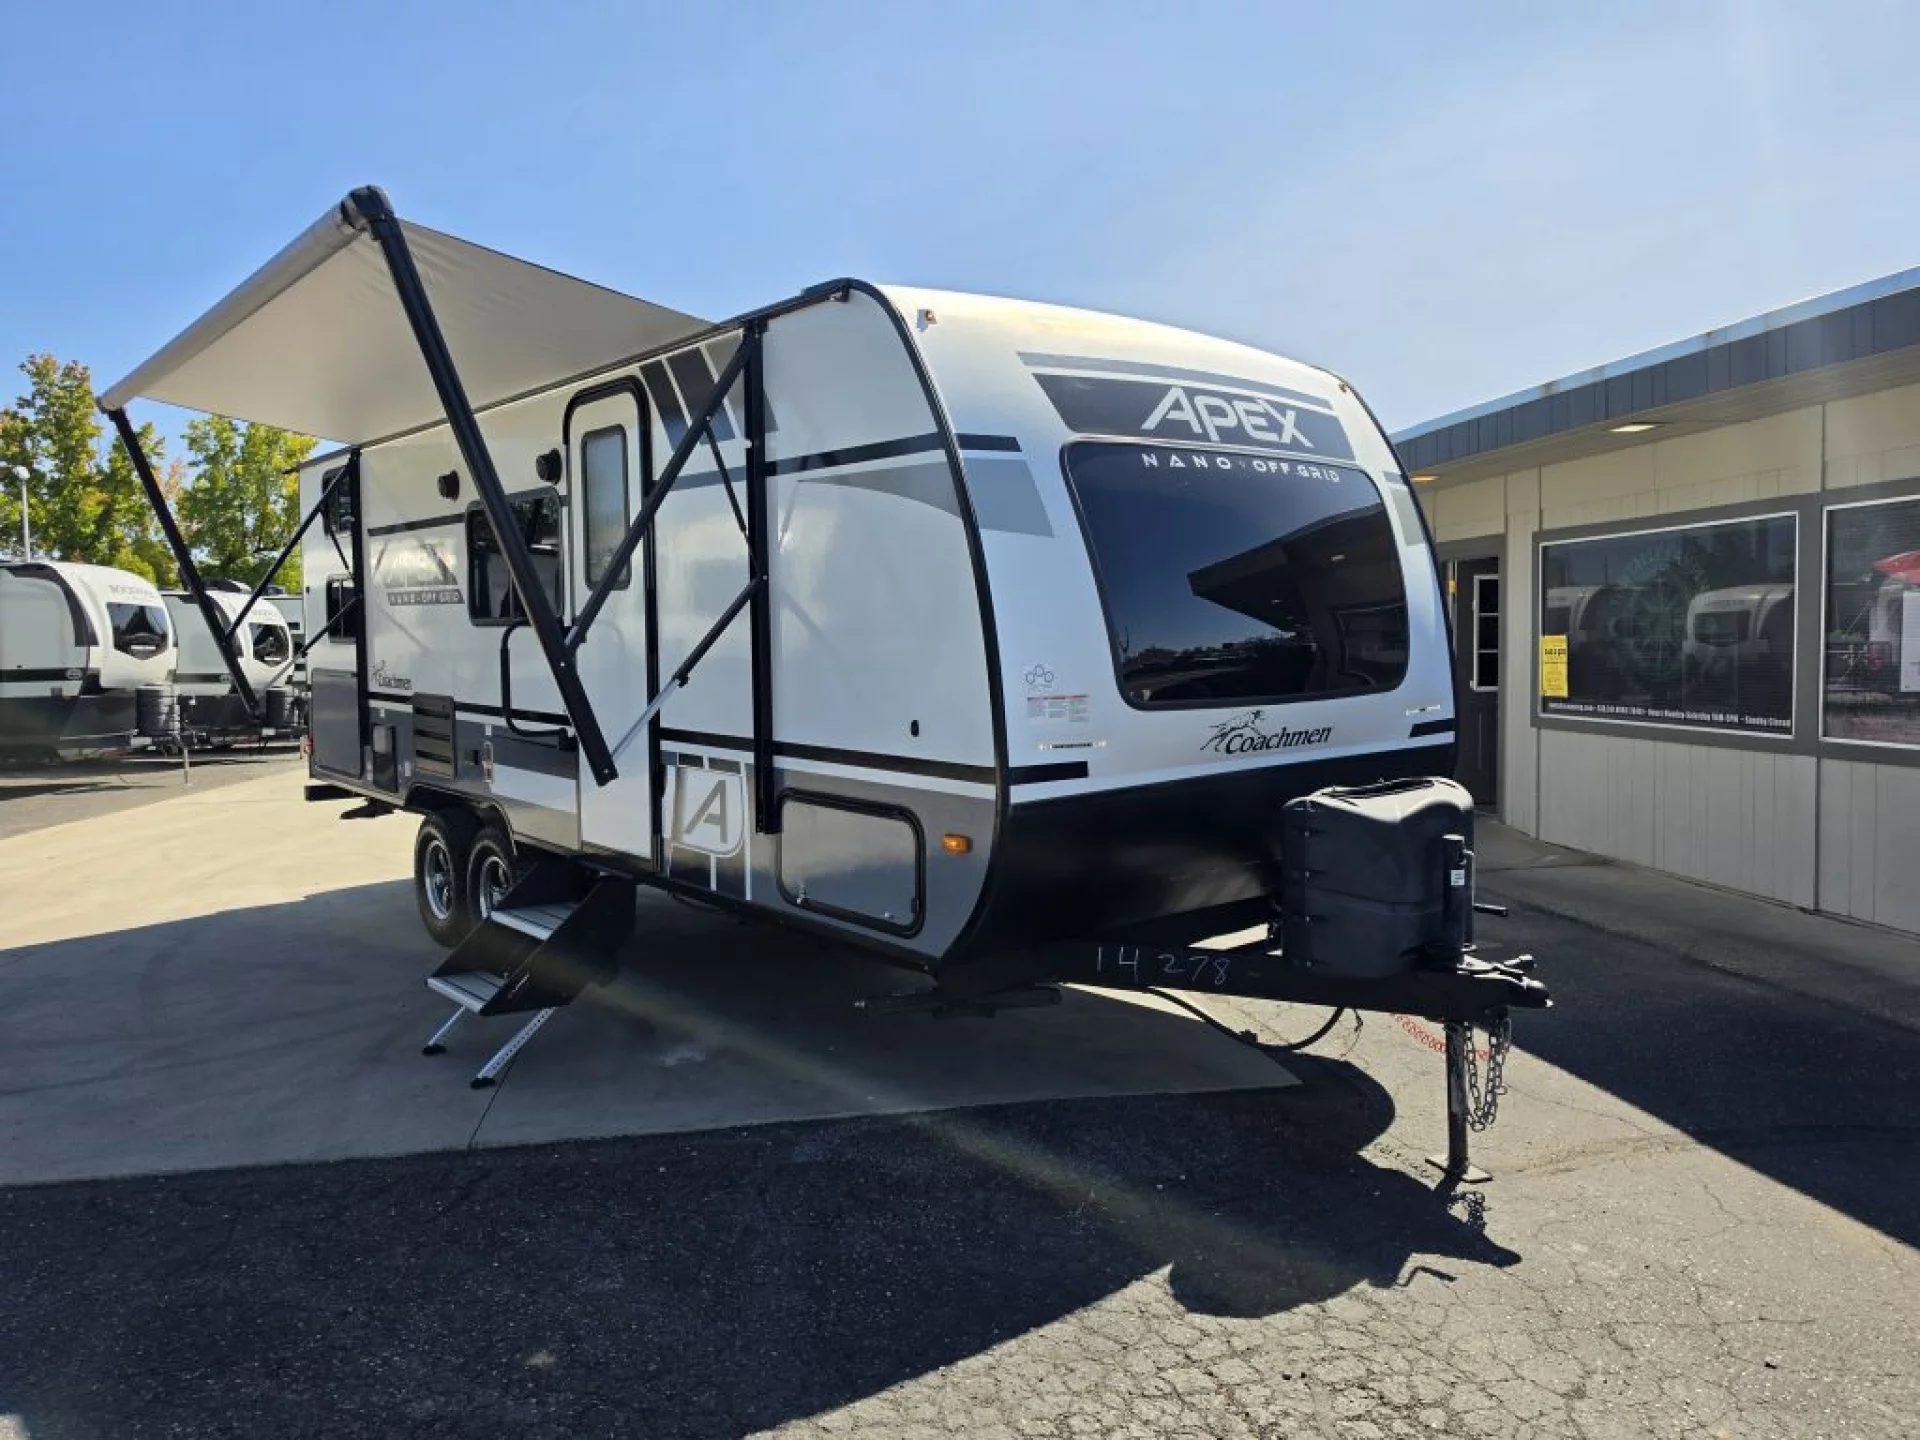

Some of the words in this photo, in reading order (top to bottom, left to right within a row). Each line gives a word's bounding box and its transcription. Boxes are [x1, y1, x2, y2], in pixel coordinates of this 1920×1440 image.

[1140, 386, 1315, 448] APEX
[1141, 453, 1232, 470] NANO
[1252, 459, 1290, 475] OFF
[1297, 465, 1340, 483] GRID
[1225, 726, 1332, 755] Coachmen
[683, 779, 728, 844] A
